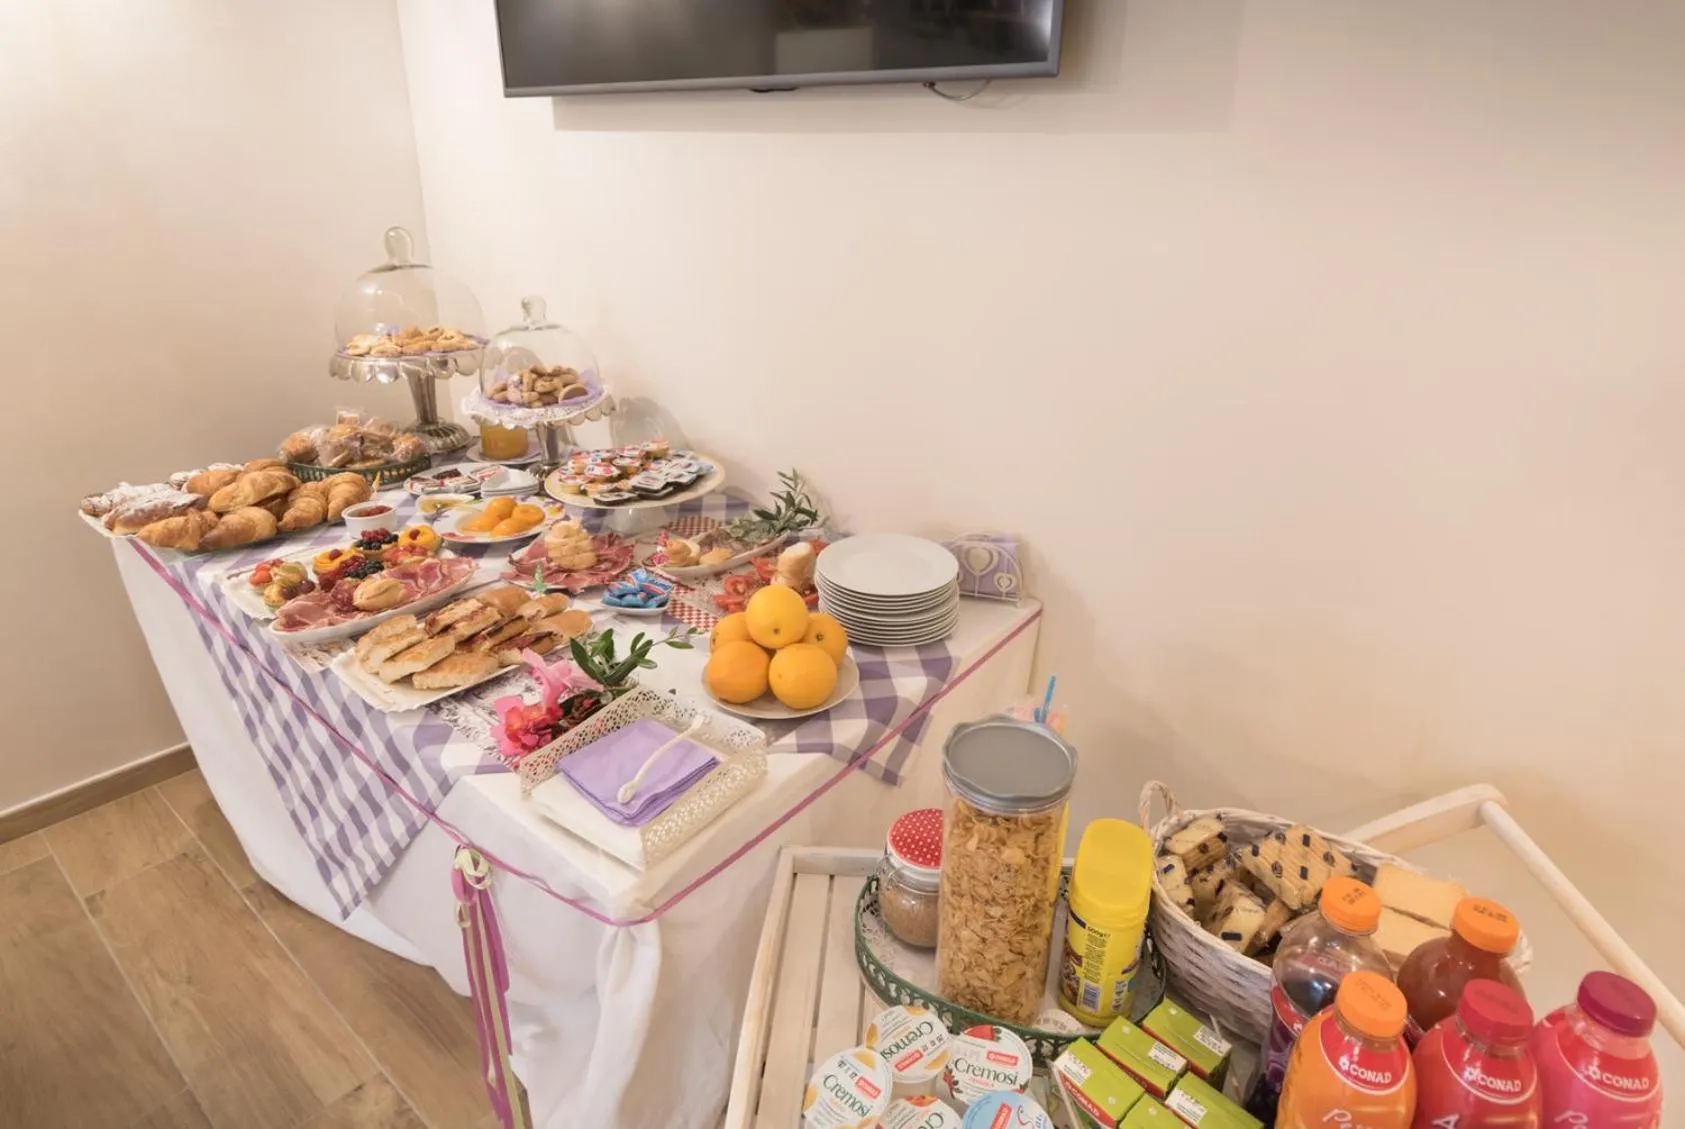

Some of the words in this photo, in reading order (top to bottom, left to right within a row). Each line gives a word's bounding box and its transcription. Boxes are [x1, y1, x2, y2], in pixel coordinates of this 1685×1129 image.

[880, 1020, 934, 1062] Cremosi
[954, 1057, 1020, 1085] Cremosi
[1349, 1063, 1392, 1084] CONAD
[1478, 1073, 1522, 1092] CONAD
[1602, 1072, 1650, 1090] CONAD
[823, 1074, 873, 1117] Cremosi
